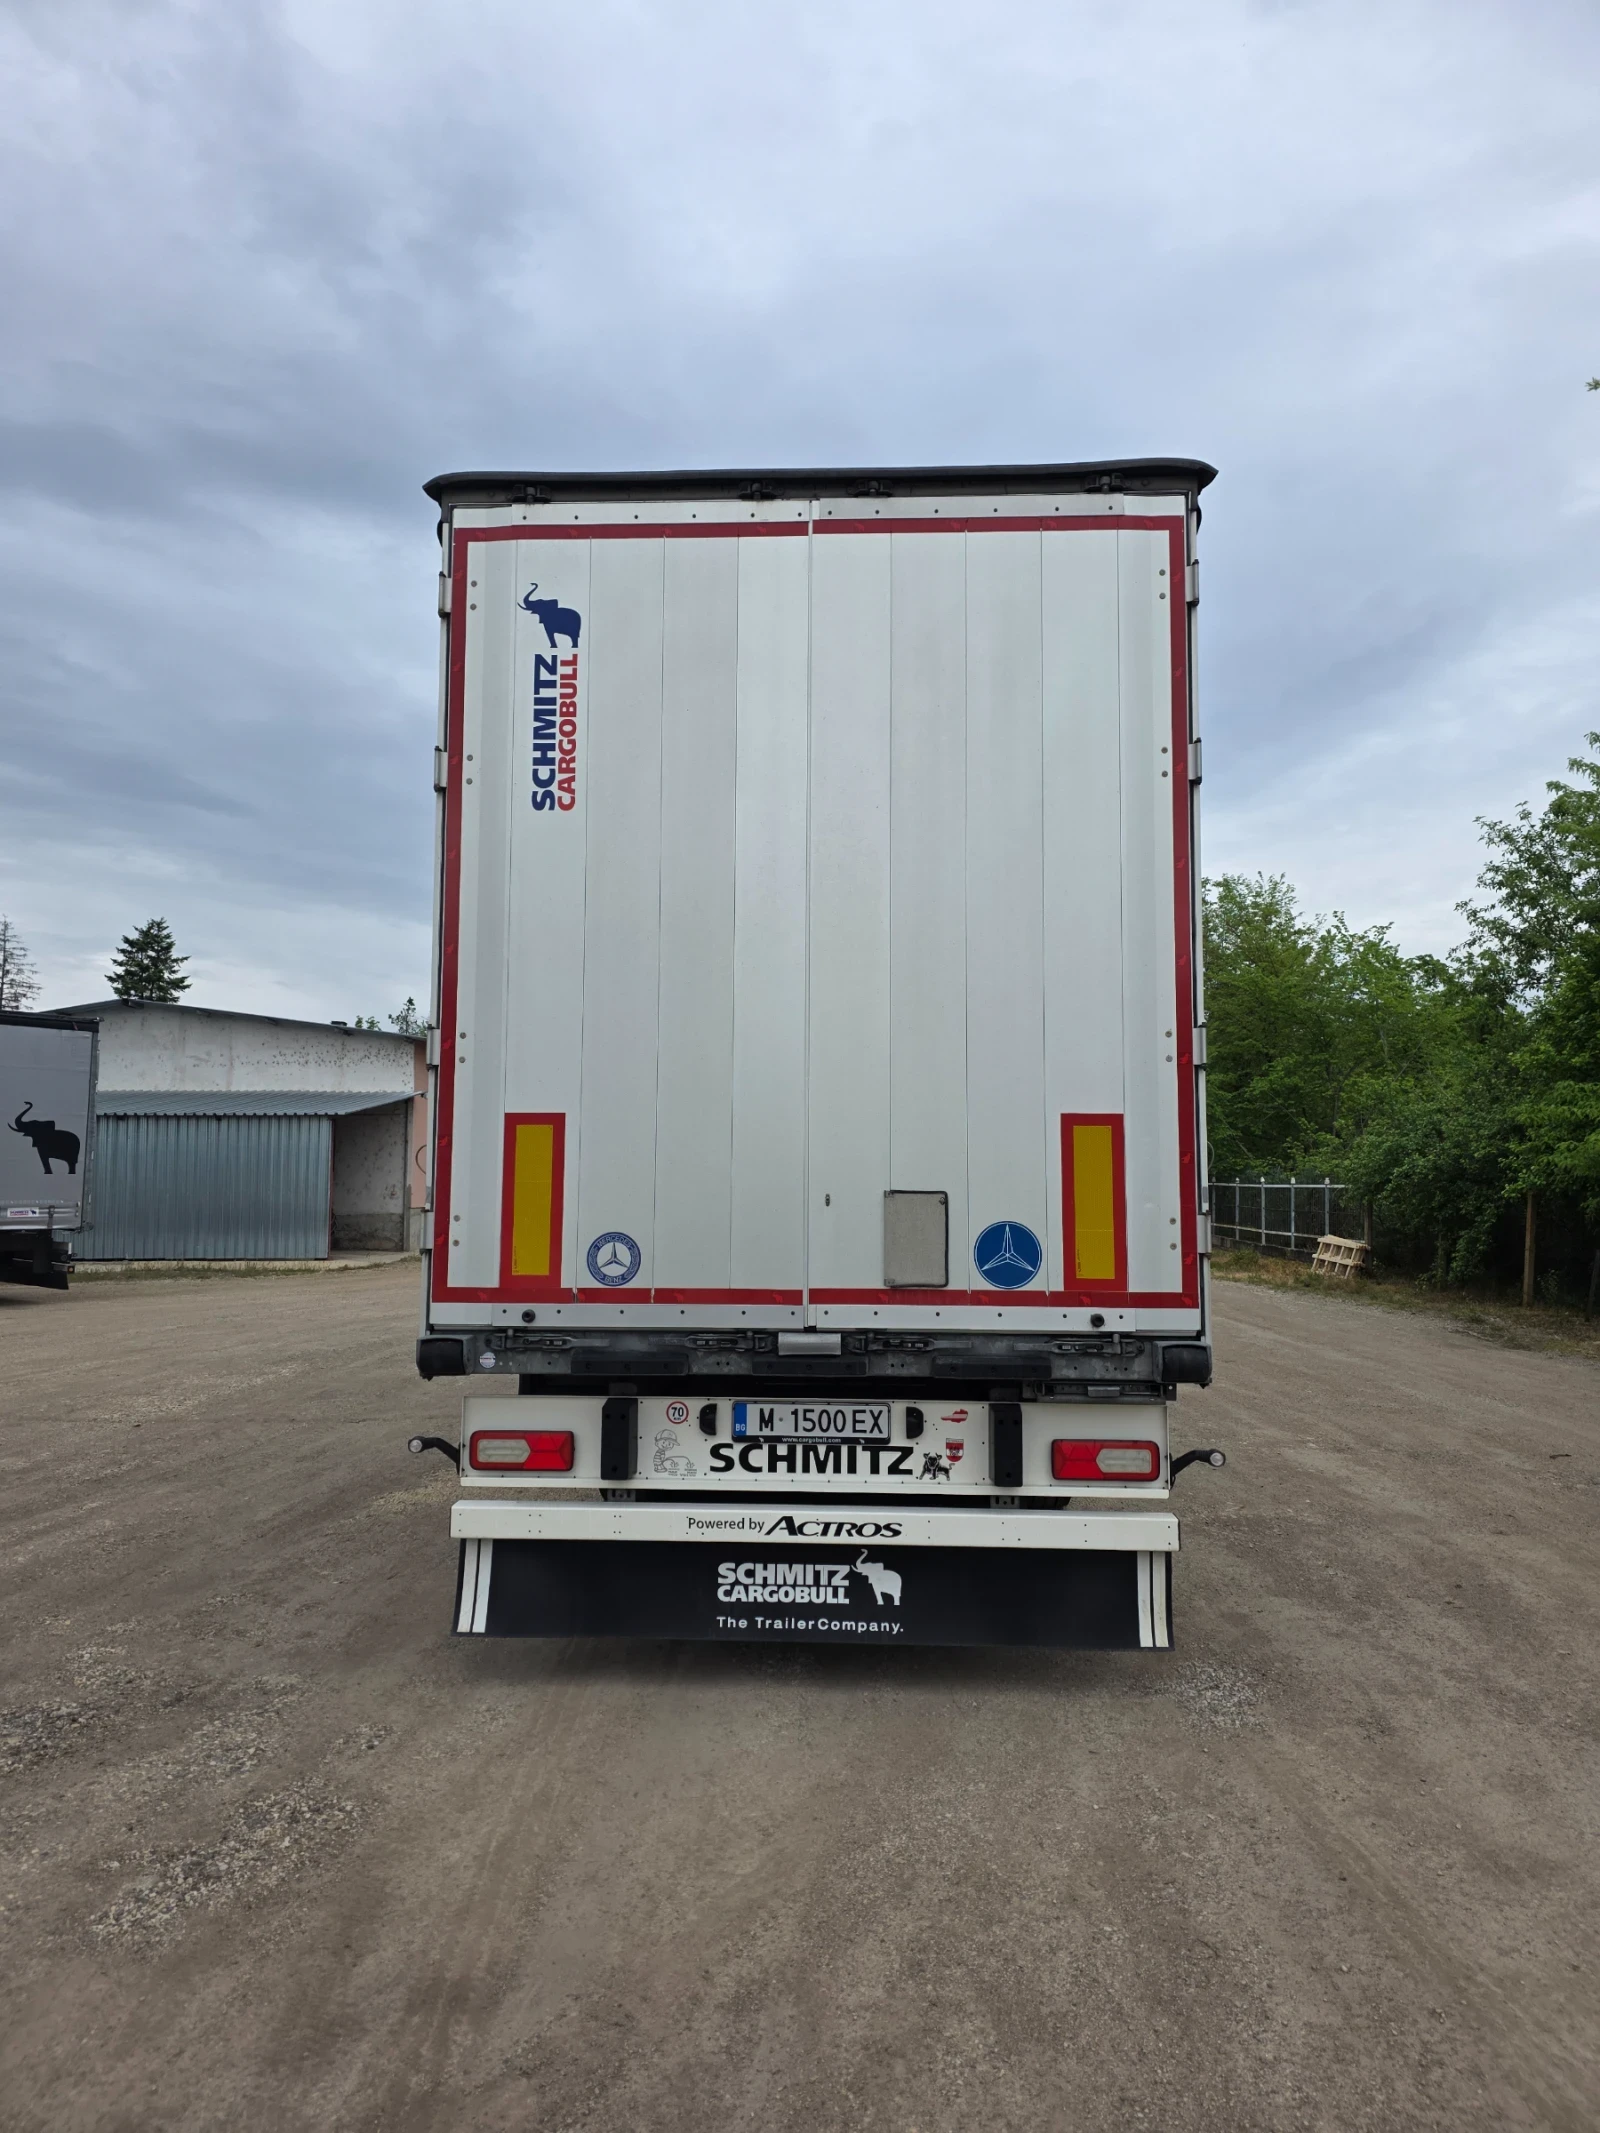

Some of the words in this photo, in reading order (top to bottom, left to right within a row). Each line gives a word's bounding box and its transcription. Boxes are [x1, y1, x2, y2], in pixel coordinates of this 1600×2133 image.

[531, 653, 558, 811] SCHMITZ
[557, 653, 579, 812] CARGOBULL
[671, 1406, 685, 1418] 70
[759, 1407, 775, 1432] M
[790, 1408, 847, 1433] 1500
[852, 1409, 884, 1434] EX
[735, 1423, 746, 1432] BG
[781, 1436, 842, 1444] www.cargobull.com
[709, 1442, 914, 1475] SCHMITZ
[687, 1517, 745, 1530] Powered
[748, 1518, 765, 1533] by
[764, 1515, 903, 1538] ACTROS
[717, 1562, 850, 1586] SCHMITZ
[717, 1585, 850, 1604] CARGOBULL
[716, 1616, 748, 1629] The
[755, 1617, 815, 1630] Trailer
